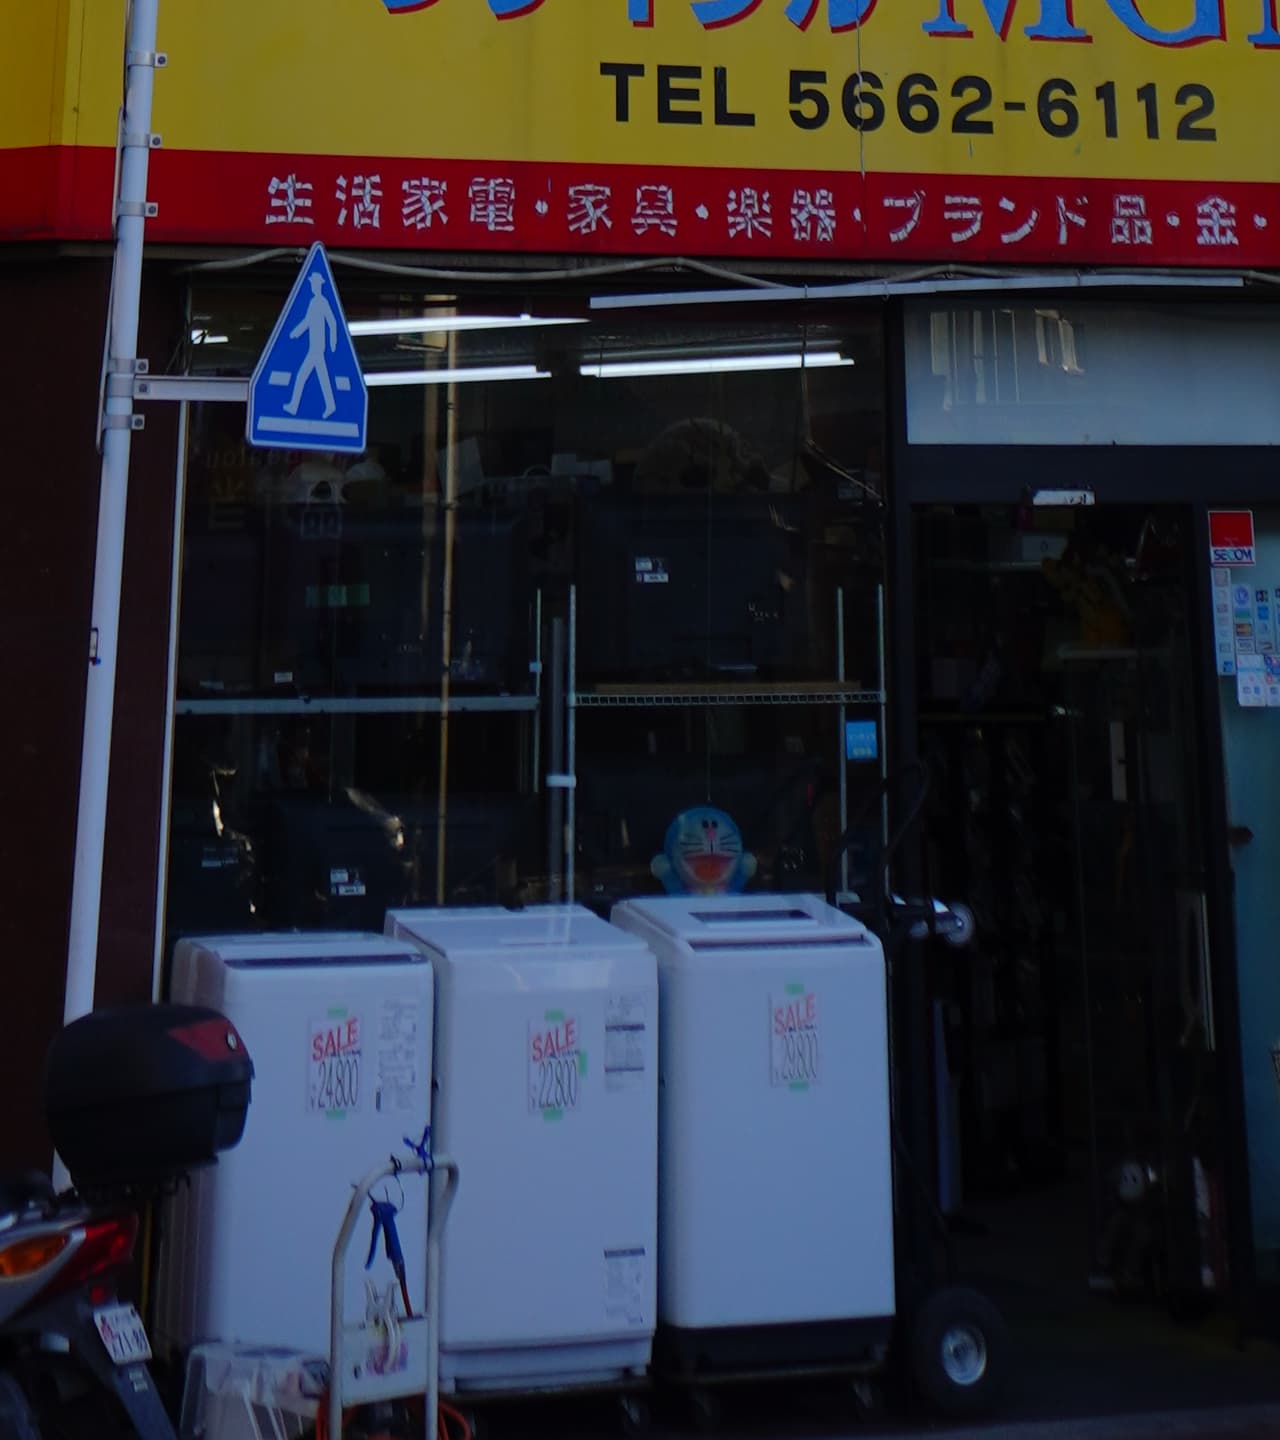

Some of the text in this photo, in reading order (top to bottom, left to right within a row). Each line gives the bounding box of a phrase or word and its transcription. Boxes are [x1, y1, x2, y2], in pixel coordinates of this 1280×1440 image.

[599, 61, 1218, 143] TEL 5662-6112
[1213, 548, 1253, 562] SECOM
[774, 993, 816, 1035] SALE
[312, 1018, 359, 1061] SALE
[532, 1019, 576, 1063] SALE
